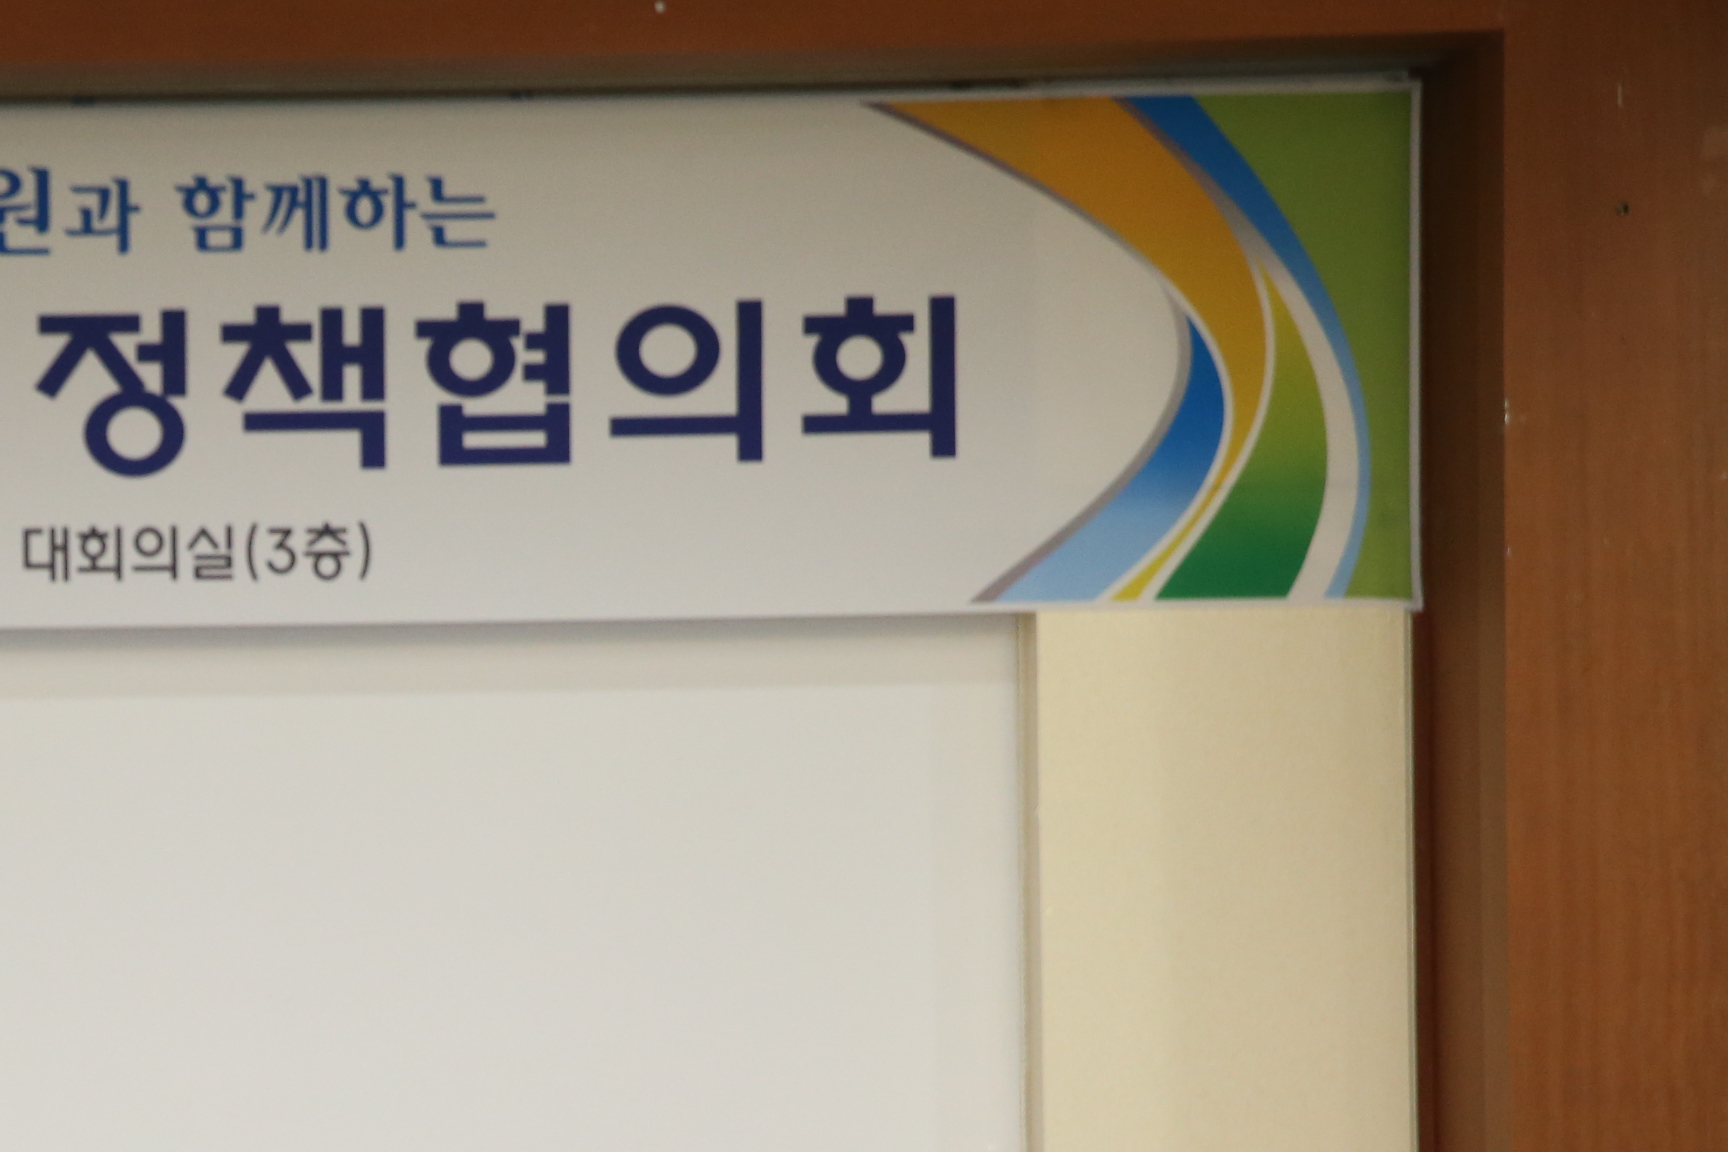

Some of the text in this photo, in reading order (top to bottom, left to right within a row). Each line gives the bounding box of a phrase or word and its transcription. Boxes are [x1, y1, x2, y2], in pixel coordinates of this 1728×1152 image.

[176, 173, 497, 252] 함께하는
[35, 294, 958, 479] 정책협의회
[21, 521, 373, 582] 대회의실(3층)
